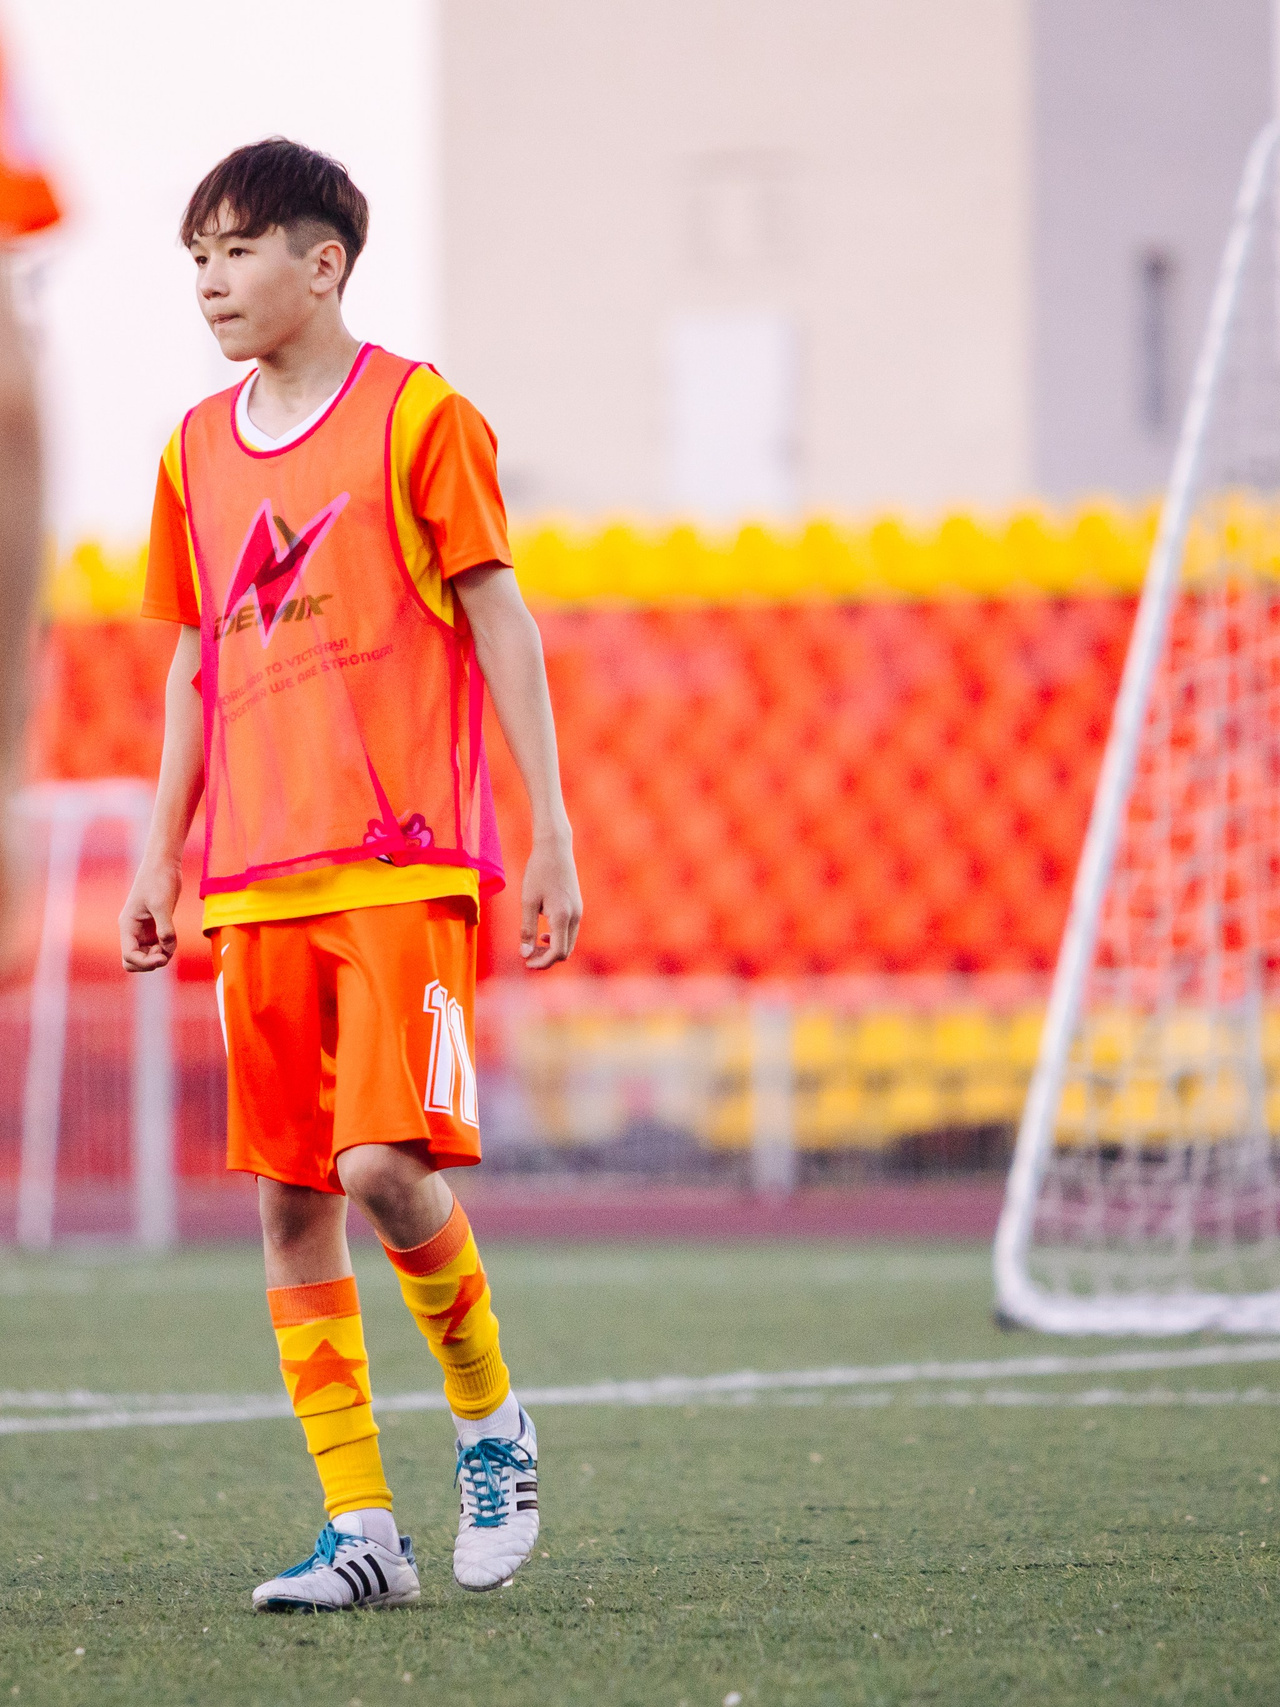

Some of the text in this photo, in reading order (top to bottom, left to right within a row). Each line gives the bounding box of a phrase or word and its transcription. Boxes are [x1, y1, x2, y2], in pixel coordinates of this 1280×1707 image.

[265, 661, 283, 677] TO
[284, 638, 350, 668] VICTORY!
[269, 678, 295, 694] WE
[297, 666, 319, 684] ARE
